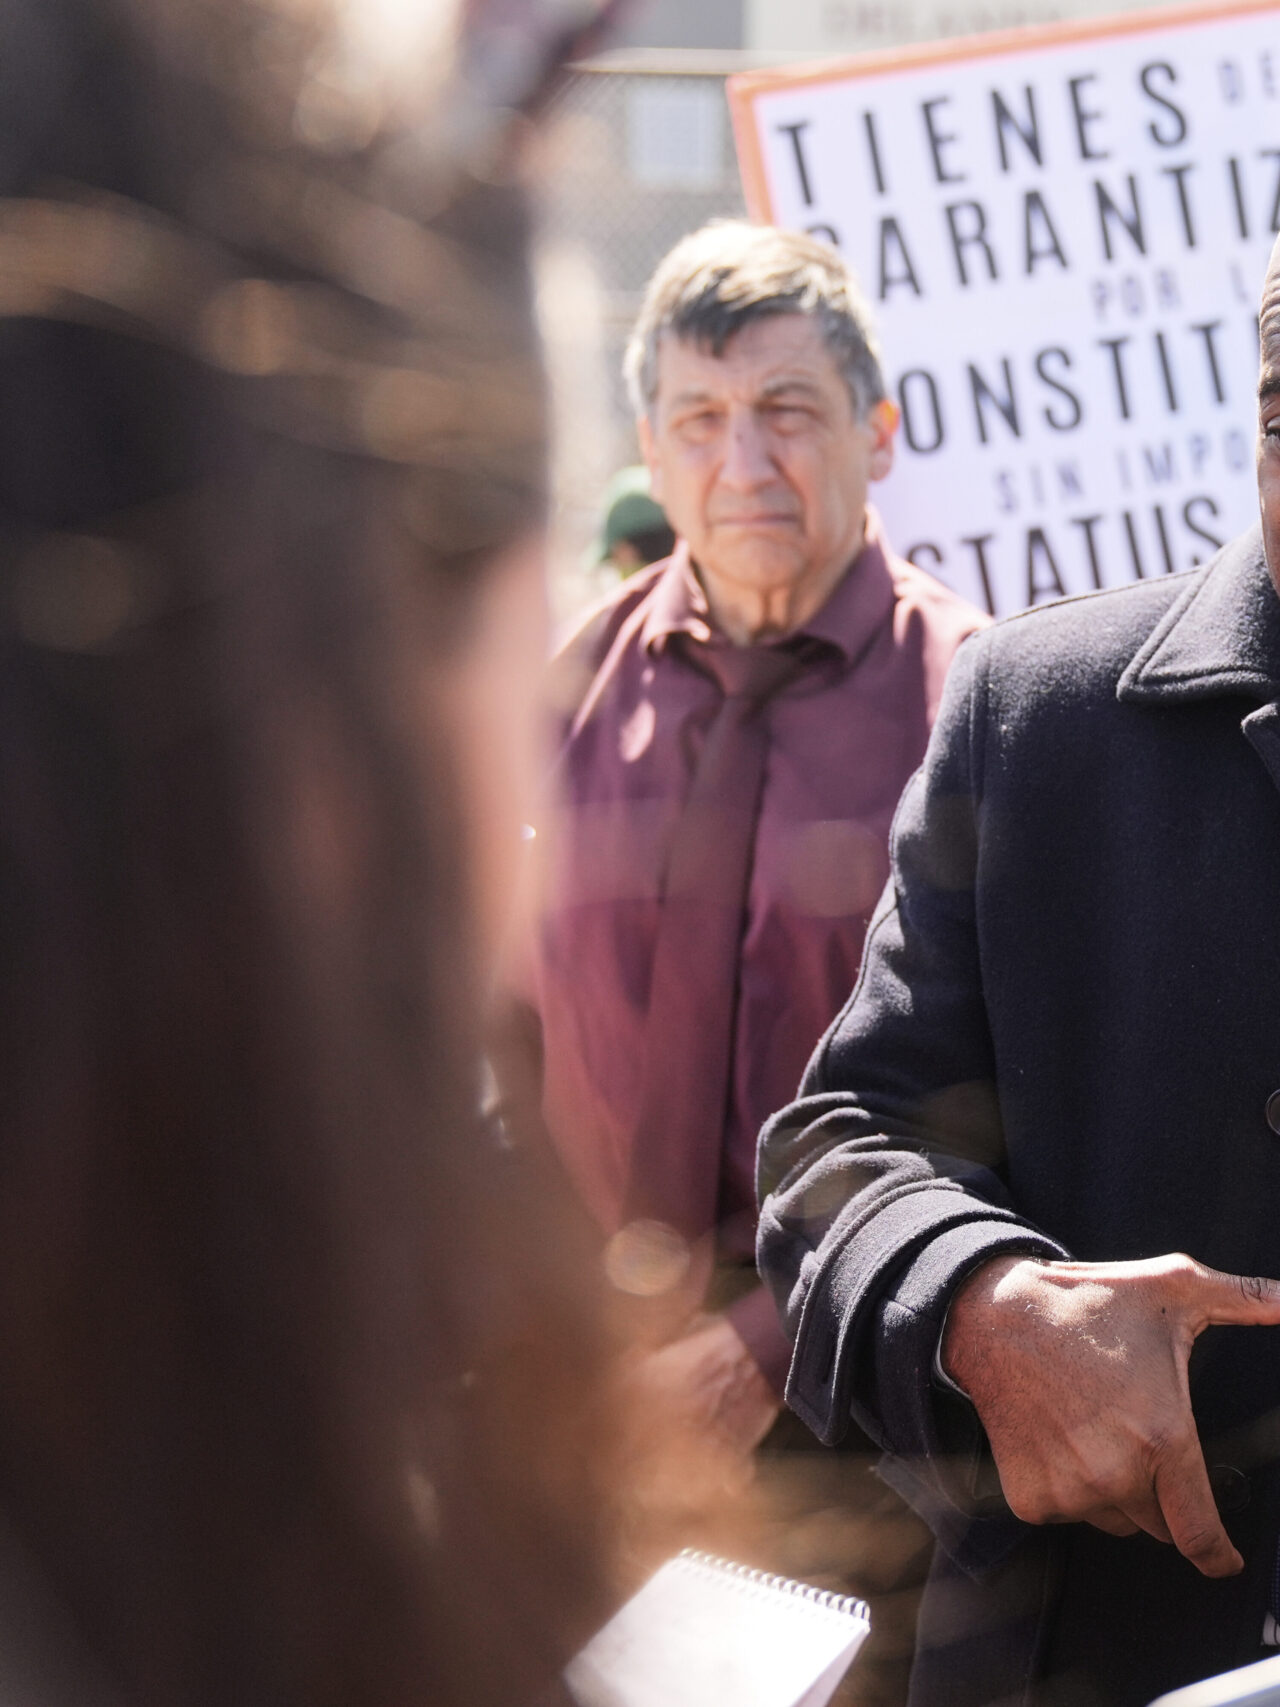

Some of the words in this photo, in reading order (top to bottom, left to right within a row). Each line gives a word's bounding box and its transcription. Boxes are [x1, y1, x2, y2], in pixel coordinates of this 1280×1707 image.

[776, 60, 1189, 206] TIENES
[1091, 268, 1180, 322] POR
[897, 312, 1261, 455] ONSTIT
[996, 456, 1084, 513] SIN
[1116, 428, 1250, 491] IMPO
